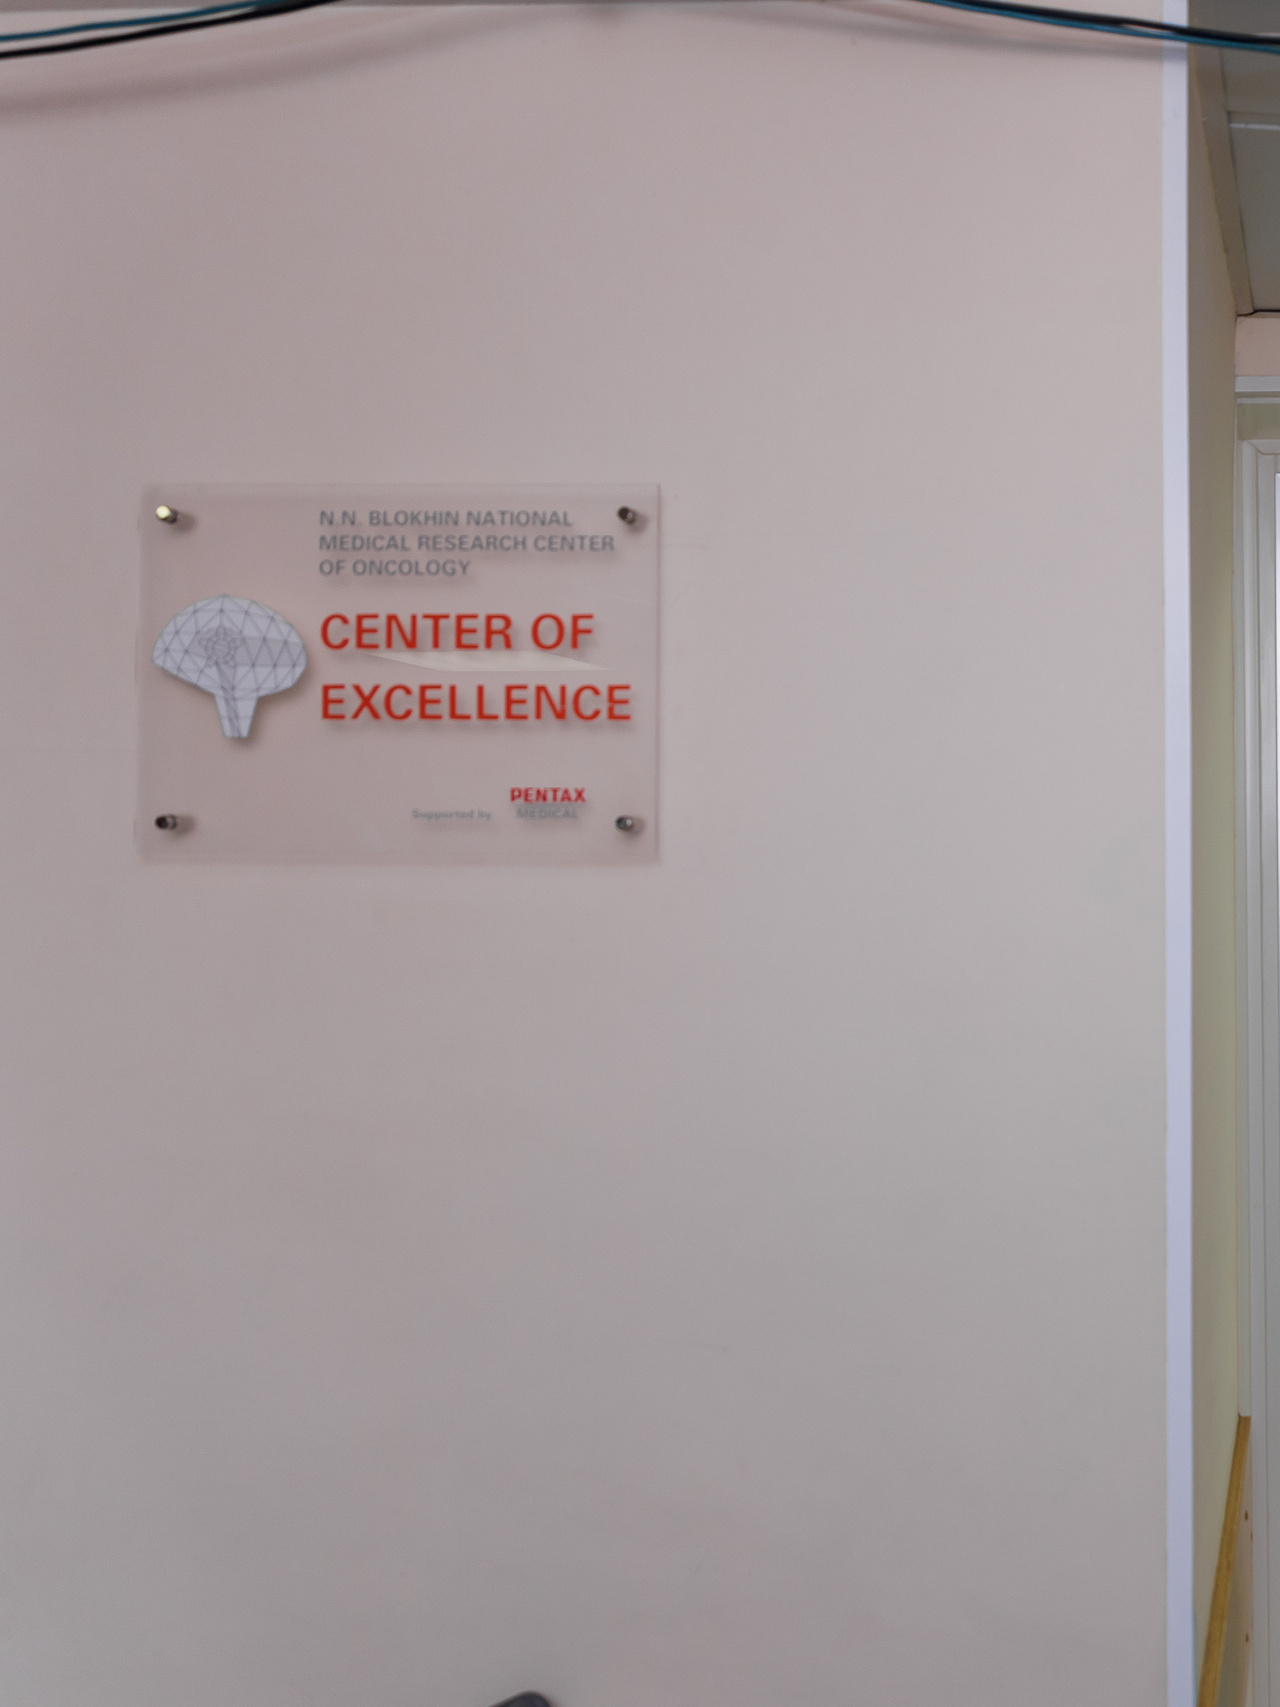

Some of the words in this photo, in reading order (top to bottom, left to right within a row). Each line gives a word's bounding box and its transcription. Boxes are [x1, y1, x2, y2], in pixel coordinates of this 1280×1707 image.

[368, 510, 459, 527] BLOKHIN
[466, 510, 573, 527] NATIONAL
[319, 534, 411, 551] MEDICAL
[417, 534, 527, 551] RESEARCH
[533, 534, 615, 551] CENTER
[319, 559, 346, 576] OF
[352, 559, 471, 576] ONCOLOGY
[320, 613, 513, 650] CENTER
[531, 613, 594, 650] OF
[321, 684, 632, 721] EXCELLENCE
[510, 787, 586, 803] PENTAX
[477, 808, 491, 820] by
[516, 807, 578, 819] MEDICAL
